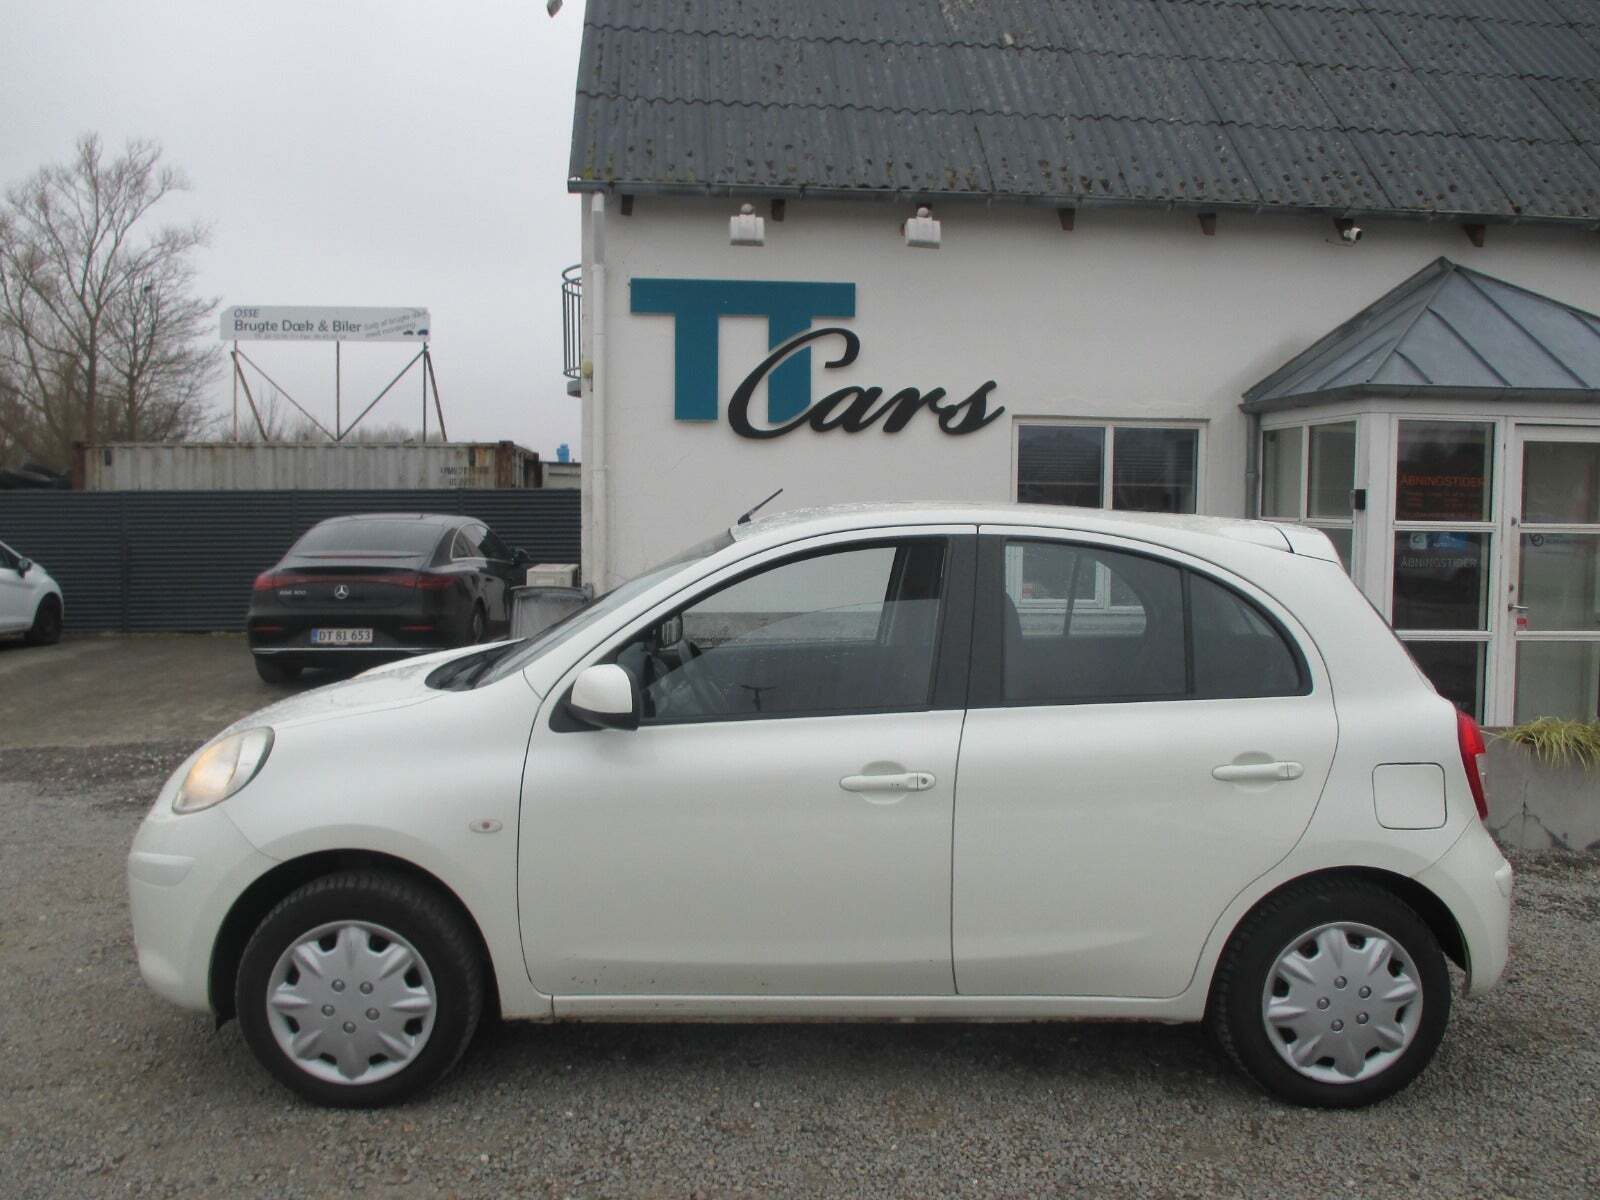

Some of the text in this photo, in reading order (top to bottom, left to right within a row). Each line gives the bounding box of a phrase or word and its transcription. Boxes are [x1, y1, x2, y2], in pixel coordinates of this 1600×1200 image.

[234, 319, 362, 333] Brugte Dæk & Biler
[630, 278, 855, 423] TT
[728, 327, 1005, 440] Cars
[319, 630, 371, 641] DT 81 653
